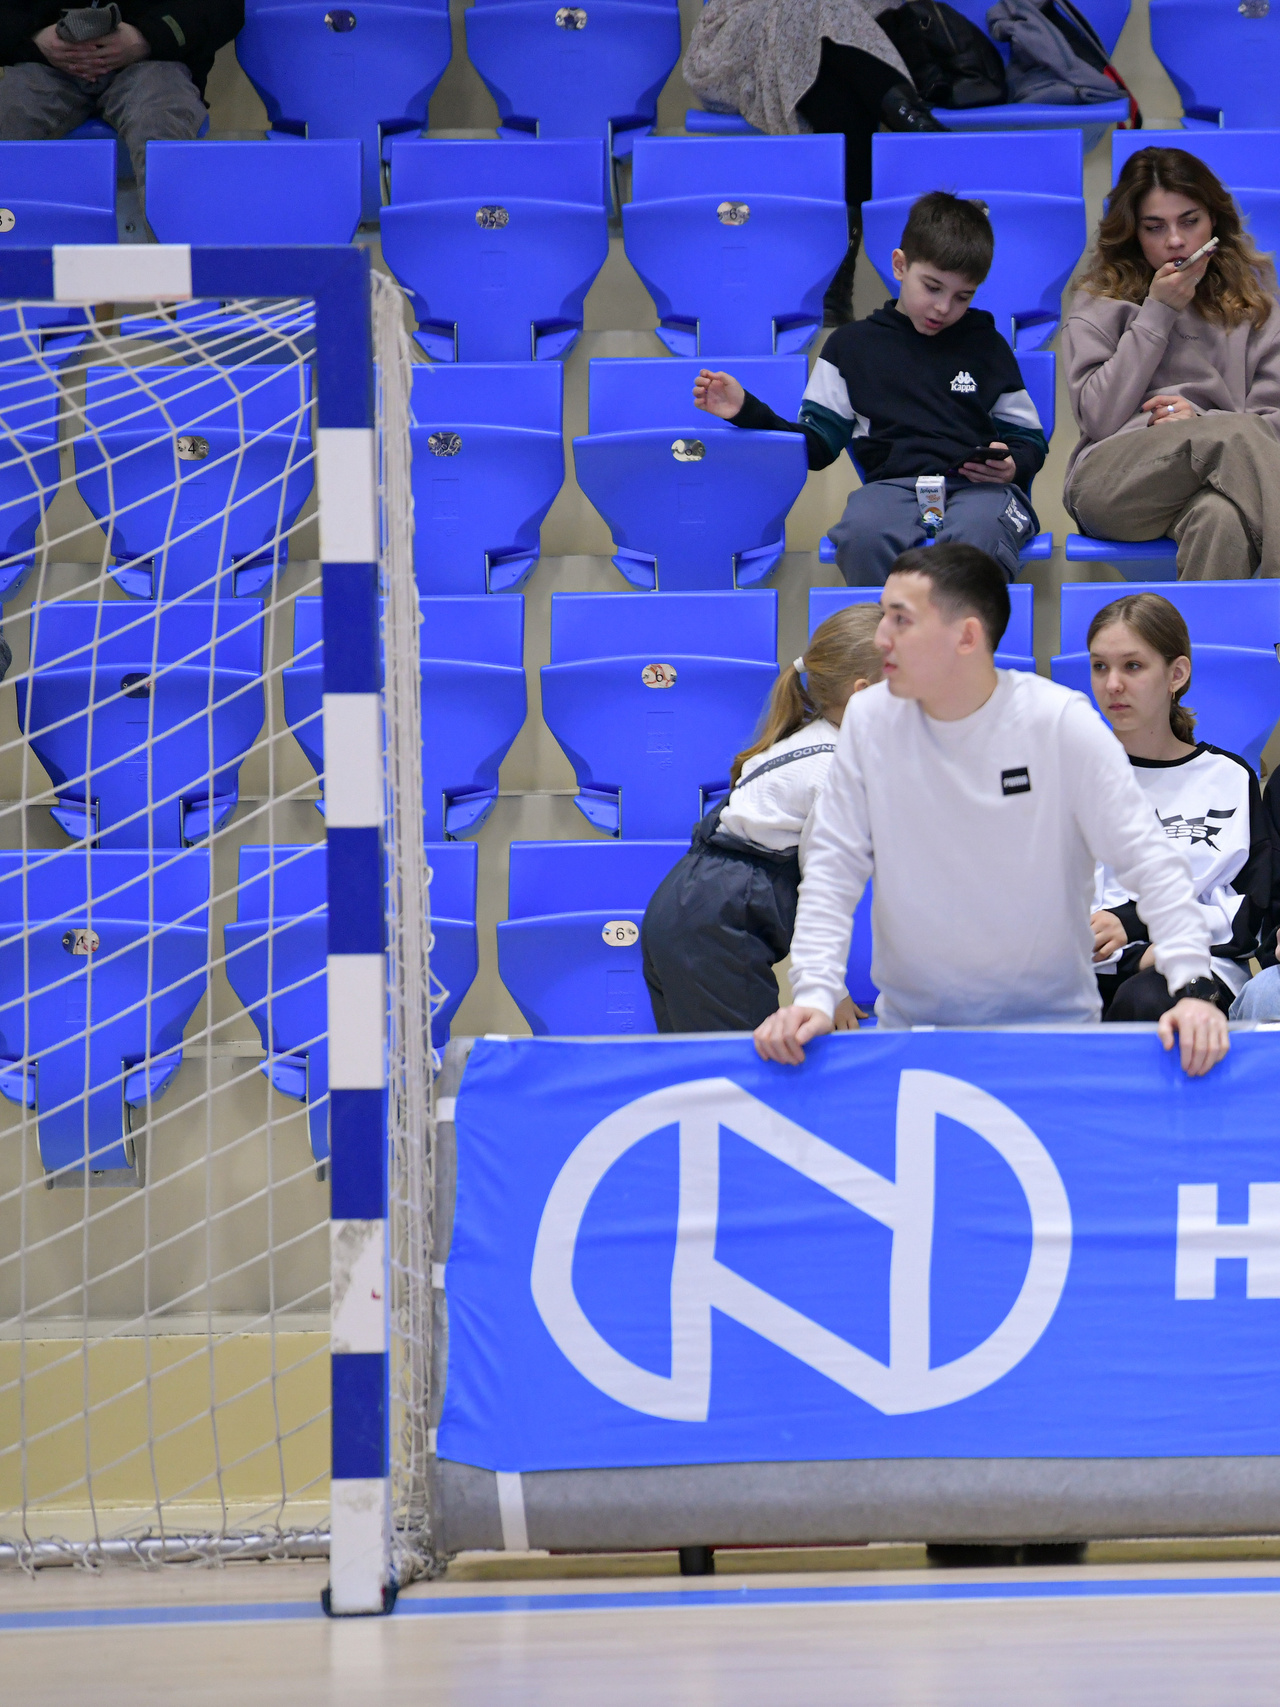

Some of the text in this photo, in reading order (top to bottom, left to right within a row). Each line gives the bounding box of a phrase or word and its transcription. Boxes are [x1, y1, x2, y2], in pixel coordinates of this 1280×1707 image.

[950, 384, 976, 392] Kappa
[188, 442, 196, 454] 4
[655, 671, 664, 682] 6
[616, 928, 624, 940] 6
